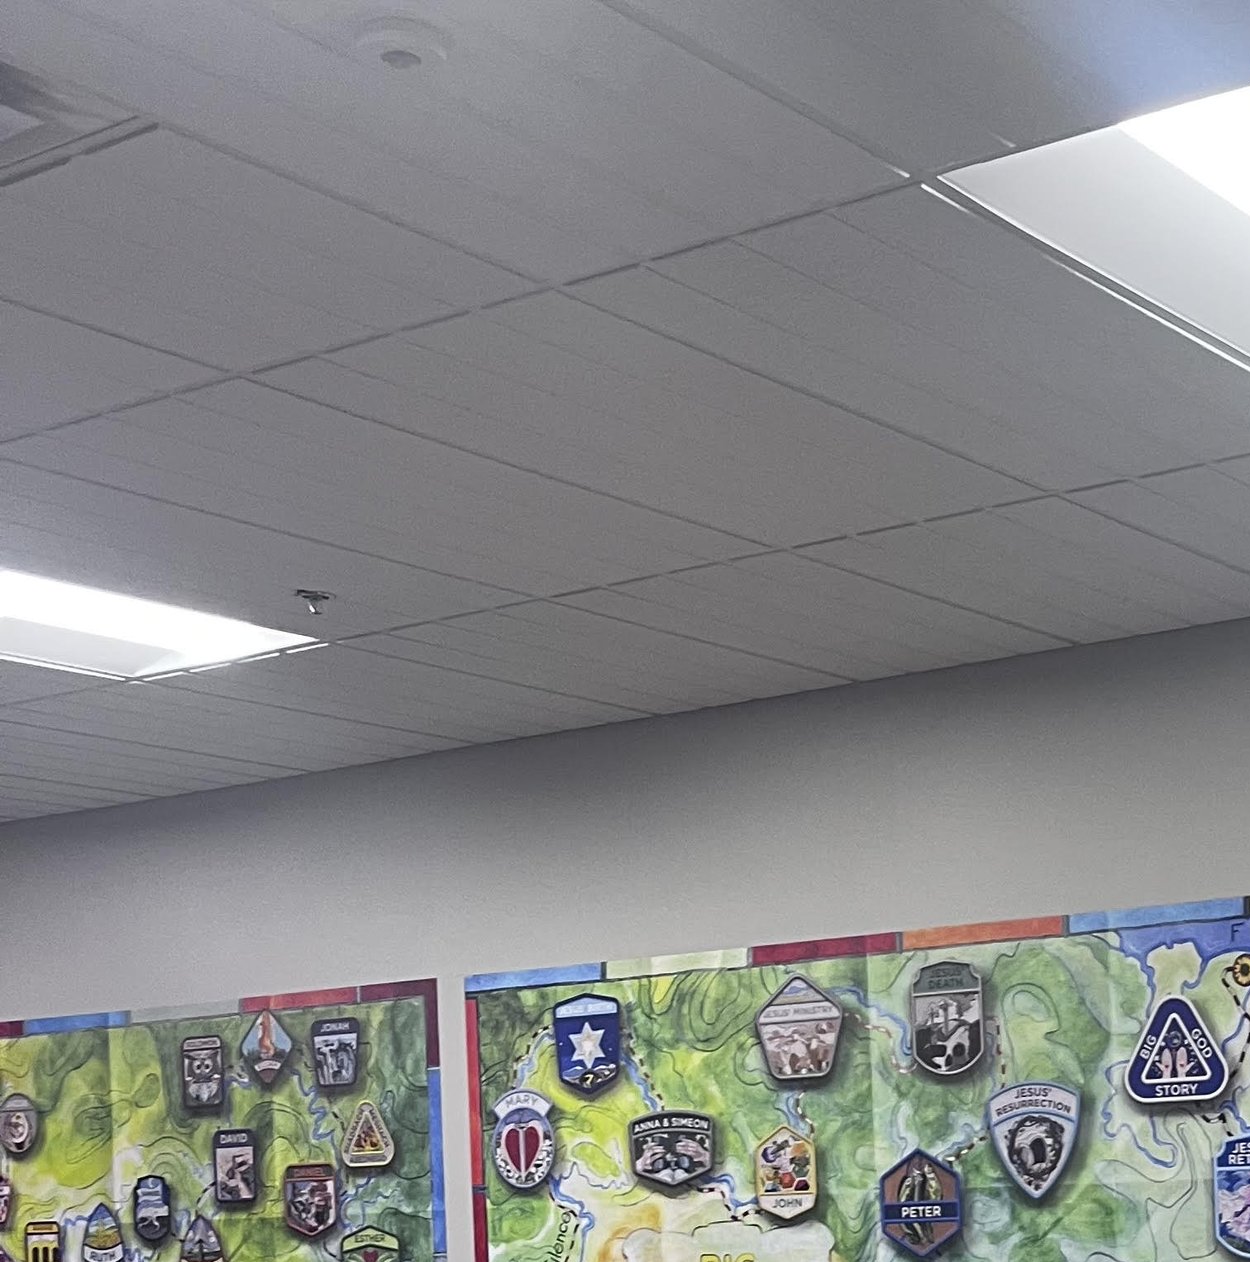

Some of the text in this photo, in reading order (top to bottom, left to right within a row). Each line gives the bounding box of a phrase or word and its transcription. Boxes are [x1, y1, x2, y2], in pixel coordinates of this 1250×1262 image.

[928, 978, 964, 989] DEATH
[792, 1005, 833, 1016] MINISTRY
[320, 1021, 350, 1033] JONAH
[1140, 1034, 1158, 1060] BIG
[1191, 1028, 1213, 1058] GOD
[1014, 1088, 1052, 1099] JESUS'
[1155, 1084, 1198, 1097] STORY
[505, 1094, 538, 1106] MARY
[995, 1100, 1072, 1117] RESURRECTION
[634, 1118, 709, 1132] ANNA & SIMEON
[219, 1134, 249, 1145] DAVID
[772, 1197, 803, 1209] JOHN
[901, 1206, 942, 1218] PETER
[354, 1233, 386, 1243] ESTHER
[90, 1251, 116, 1262] RUTH
